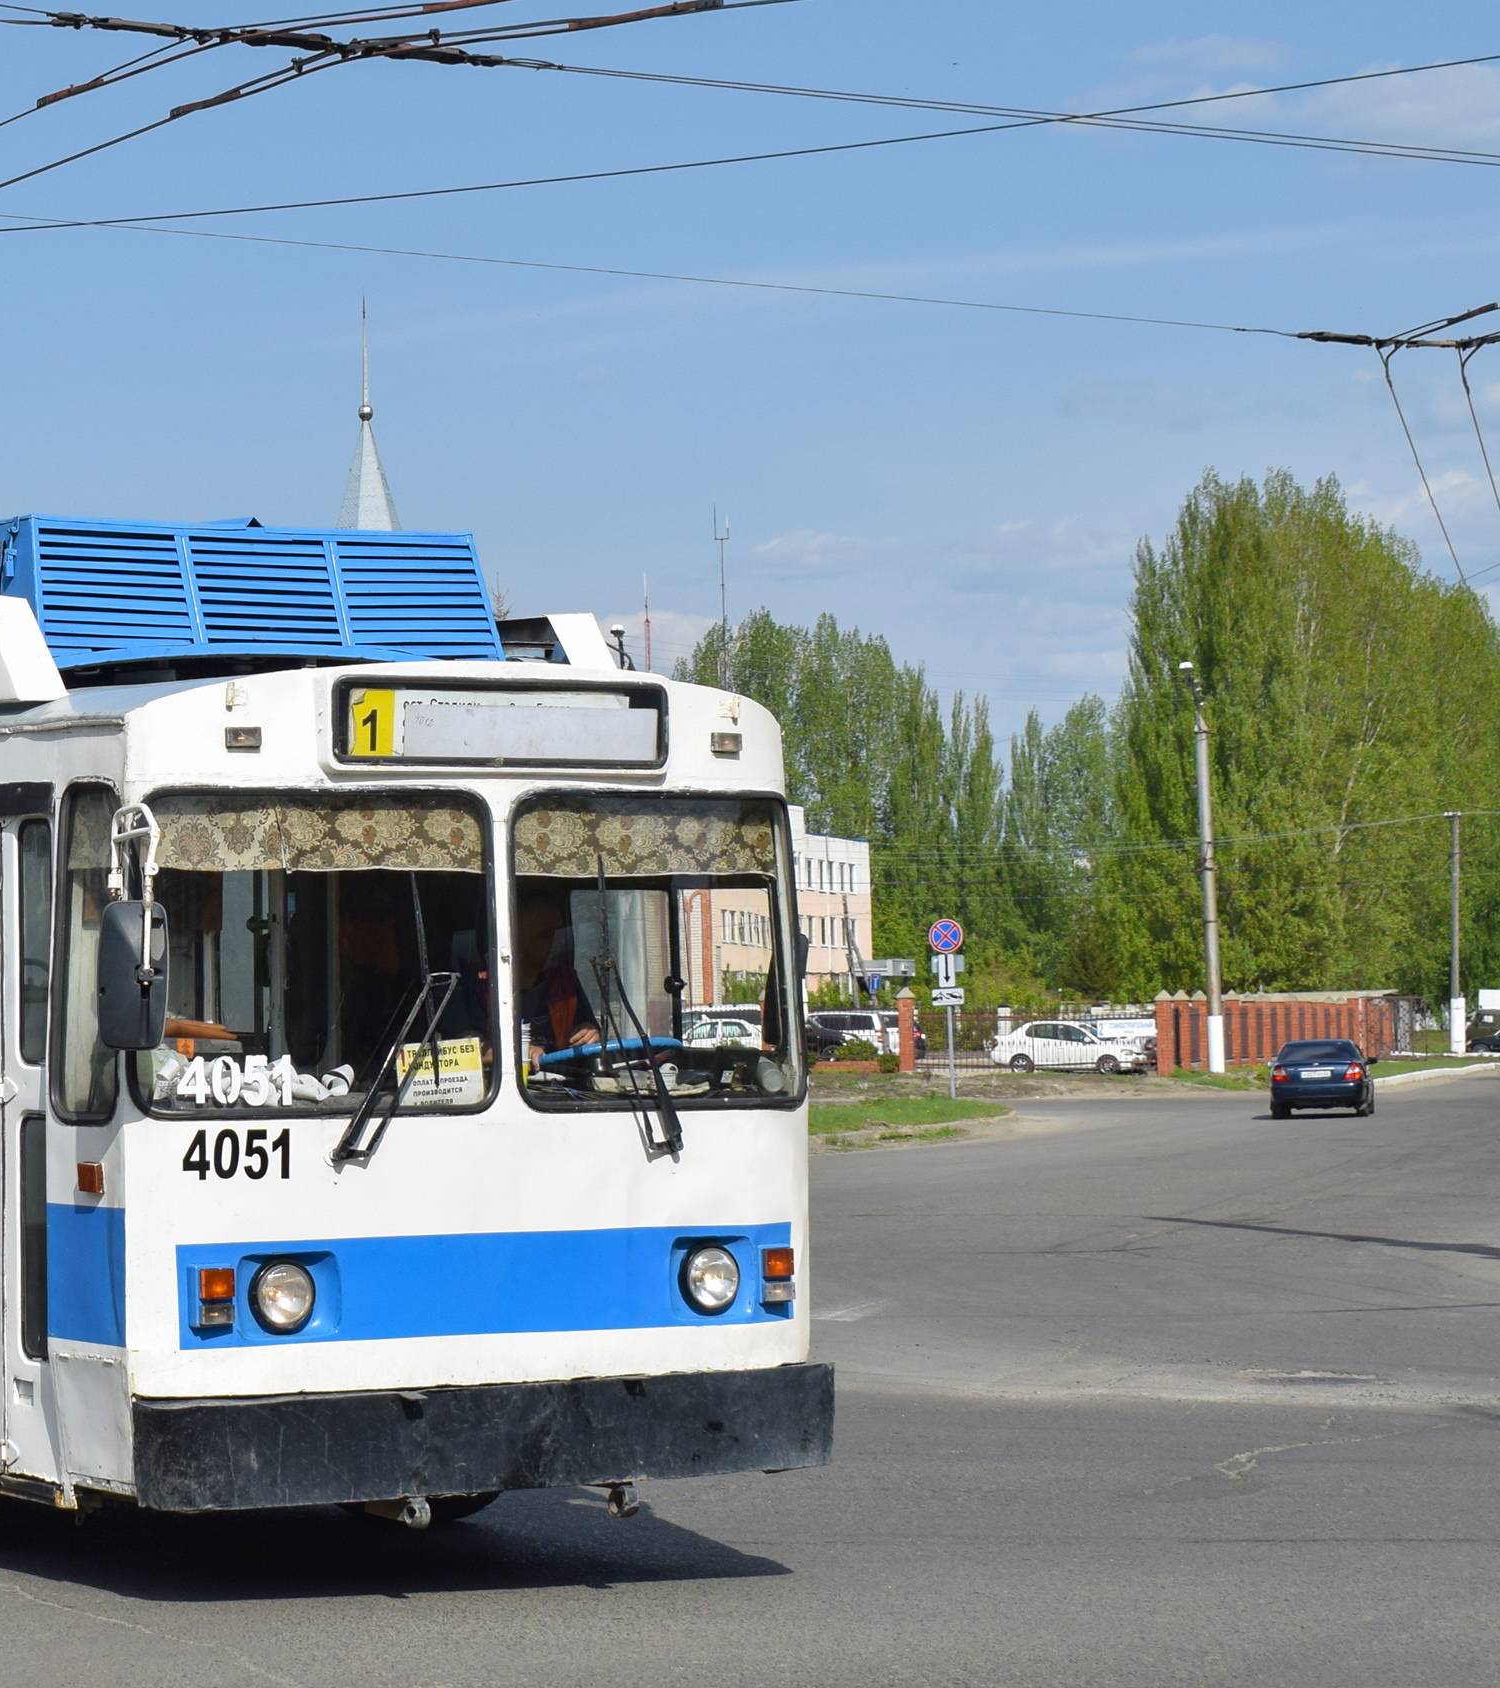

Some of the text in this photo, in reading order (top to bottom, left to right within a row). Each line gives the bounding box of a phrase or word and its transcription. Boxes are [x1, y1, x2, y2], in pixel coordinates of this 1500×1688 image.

[362, 708, 378, 752] 1
[460, 1044, 475, 1053] БЕЗ
[408, 1058, 459, 1071] ОНДУТОРА
[176, 1055, 293, 1106] 4051
[413, 1087, 463, 1097] ПРОИЗВОДИТСЯ
[182, 1128, 291, 1180] 4051
